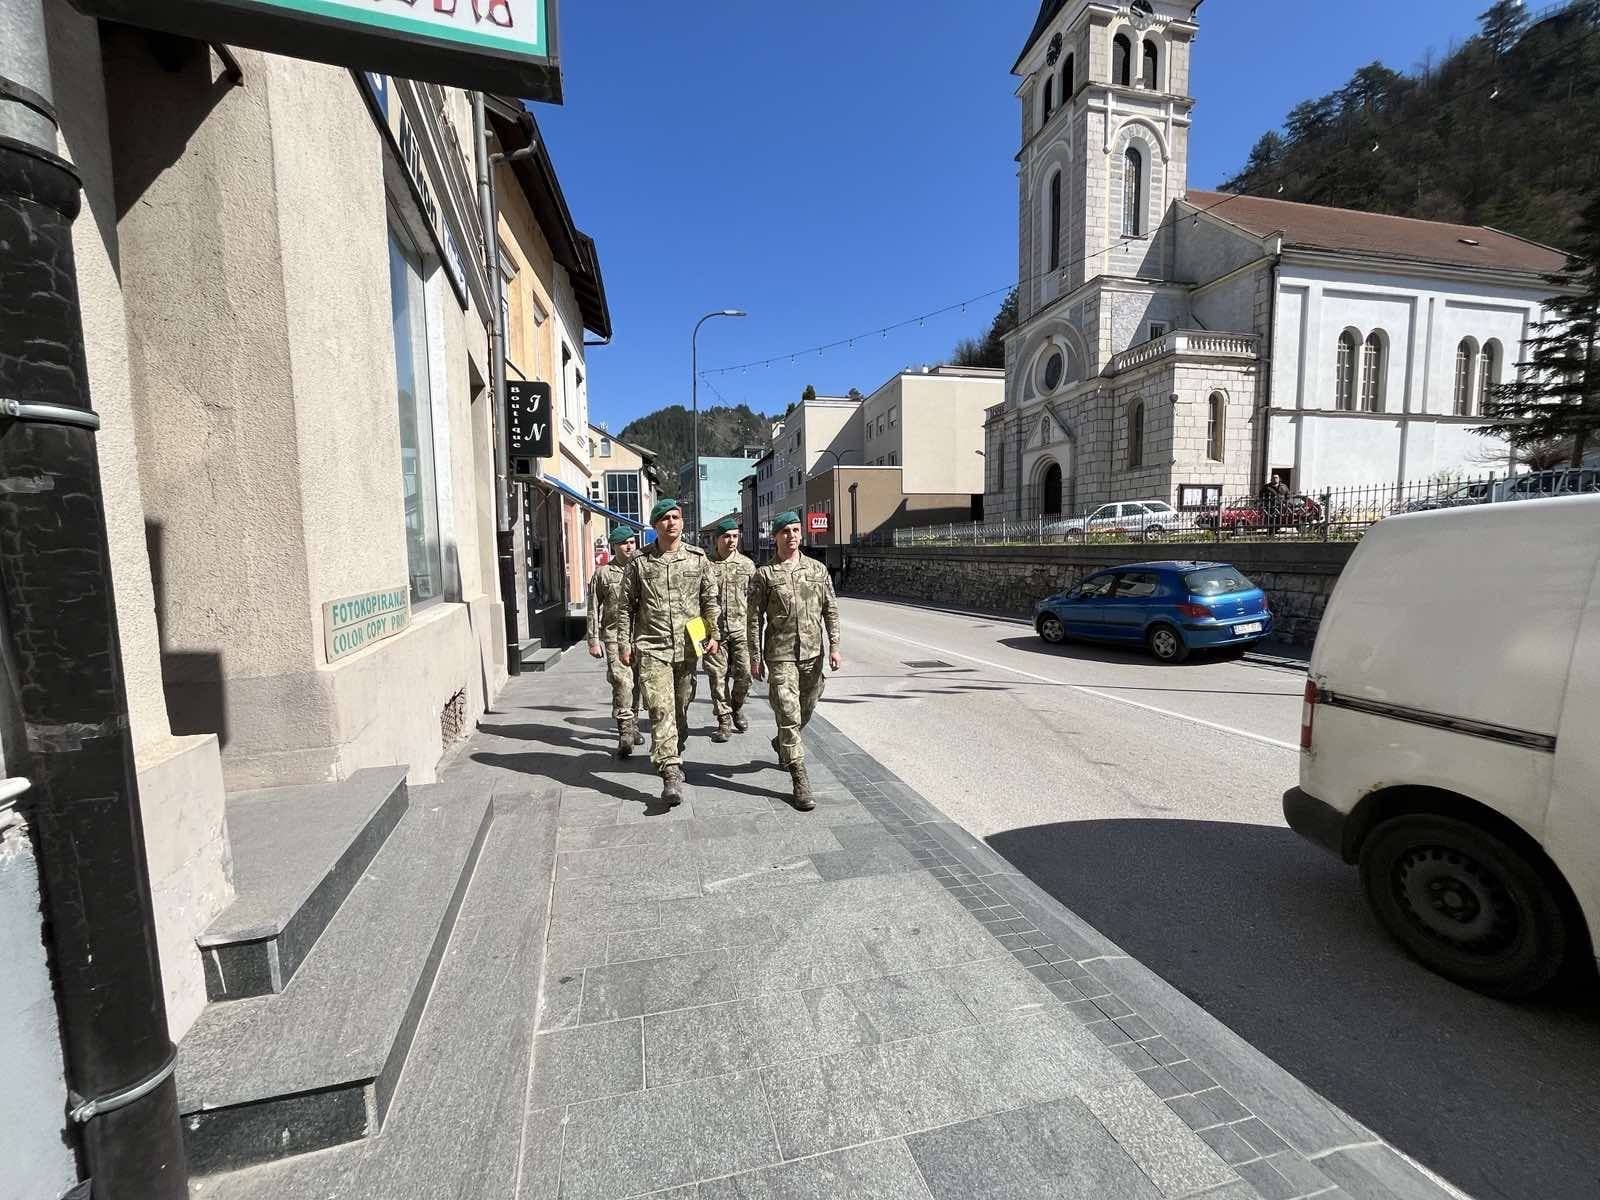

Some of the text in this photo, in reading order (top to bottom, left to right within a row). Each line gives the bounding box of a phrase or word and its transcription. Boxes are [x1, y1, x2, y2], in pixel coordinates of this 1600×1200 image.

[510, 386, 521, 448] Boutique
[333, 627, 364, 655] COLOR
[366, 618, 386, 639] COPY
